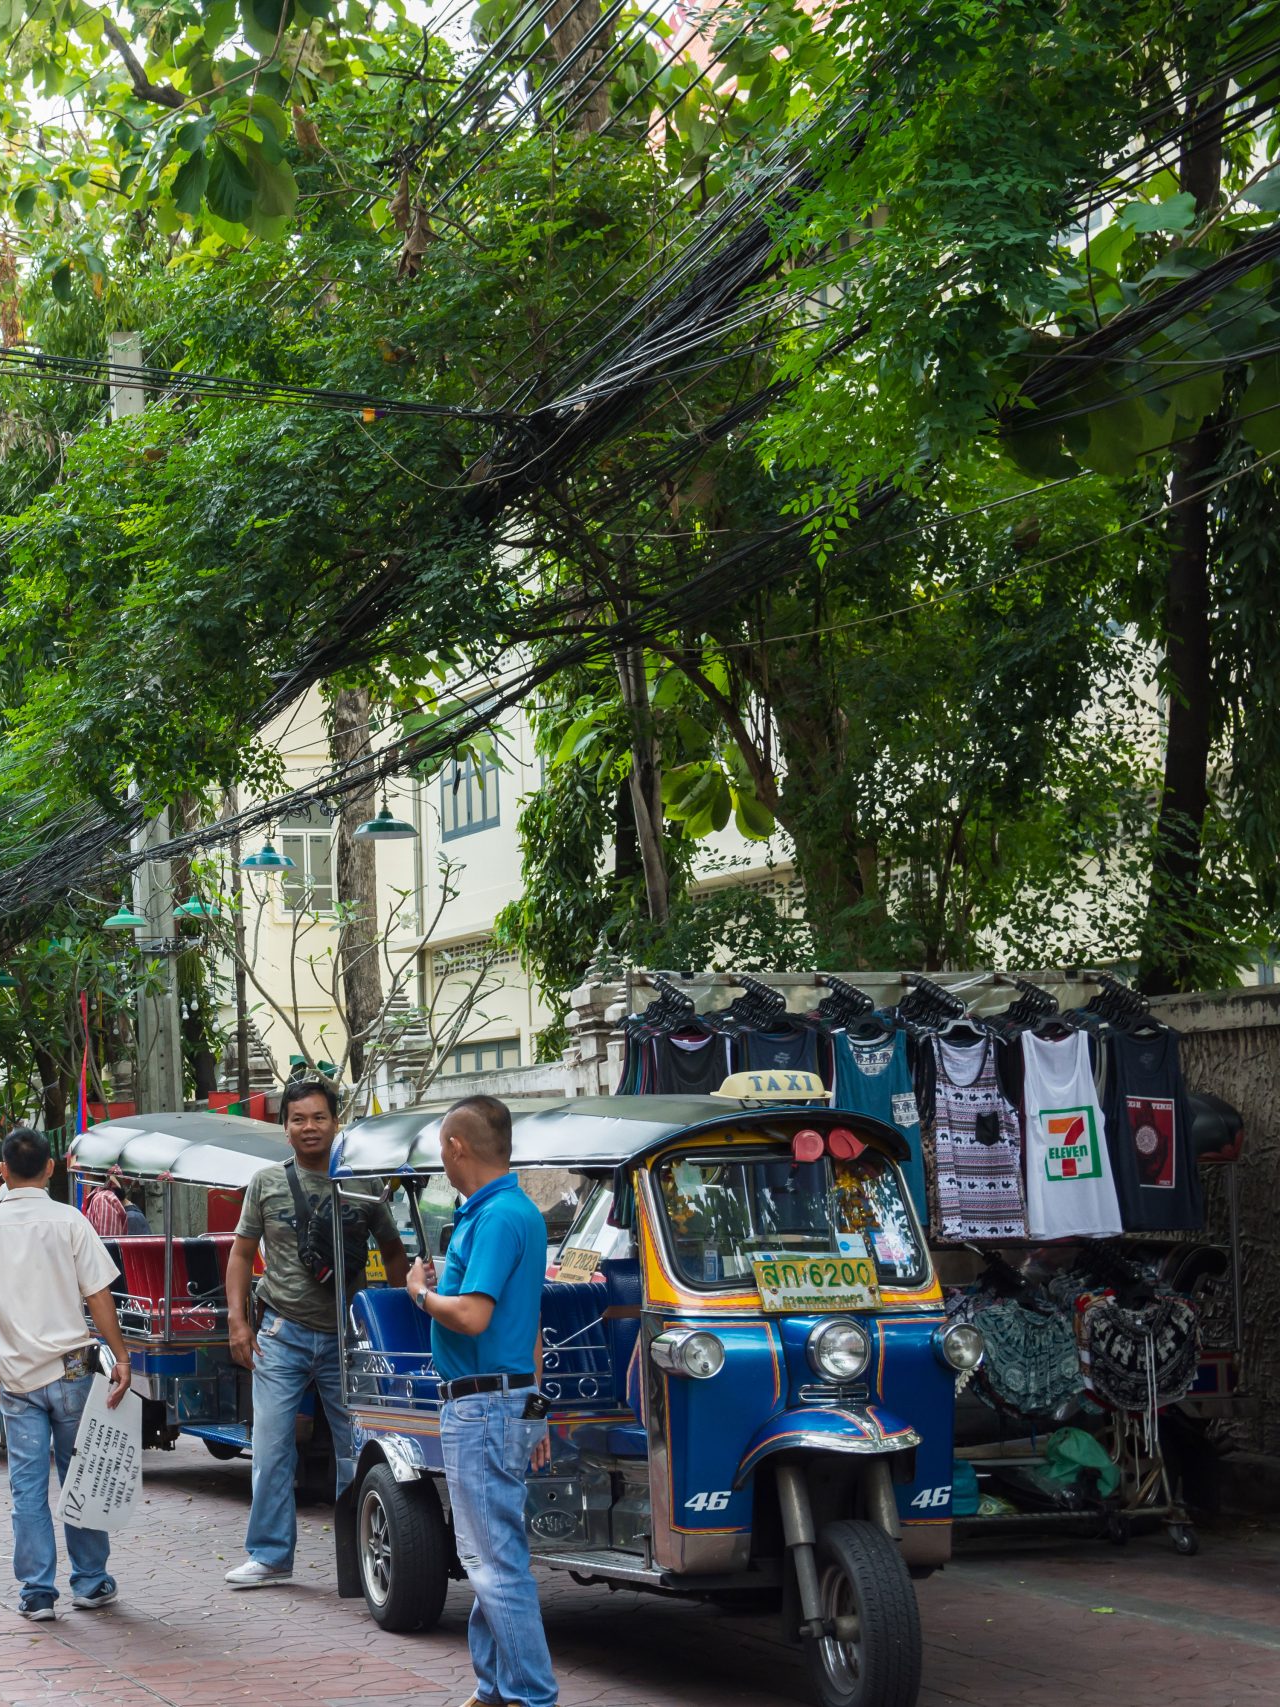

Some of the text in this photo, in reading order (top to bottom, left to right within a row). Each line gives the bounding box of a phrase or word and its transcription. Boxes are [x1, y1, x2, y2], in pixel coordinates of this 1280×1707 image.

[748, 1074, 814, 1092] TAXI
[761, 1262, 871, 1288] สก 6200
[103, 1427, 113, 1454] LUCKY
[123, 1445, 136, 1473] CITY
[684, 1490, 732, 1512] 46
[910, 1485, 952, 1509] 46
